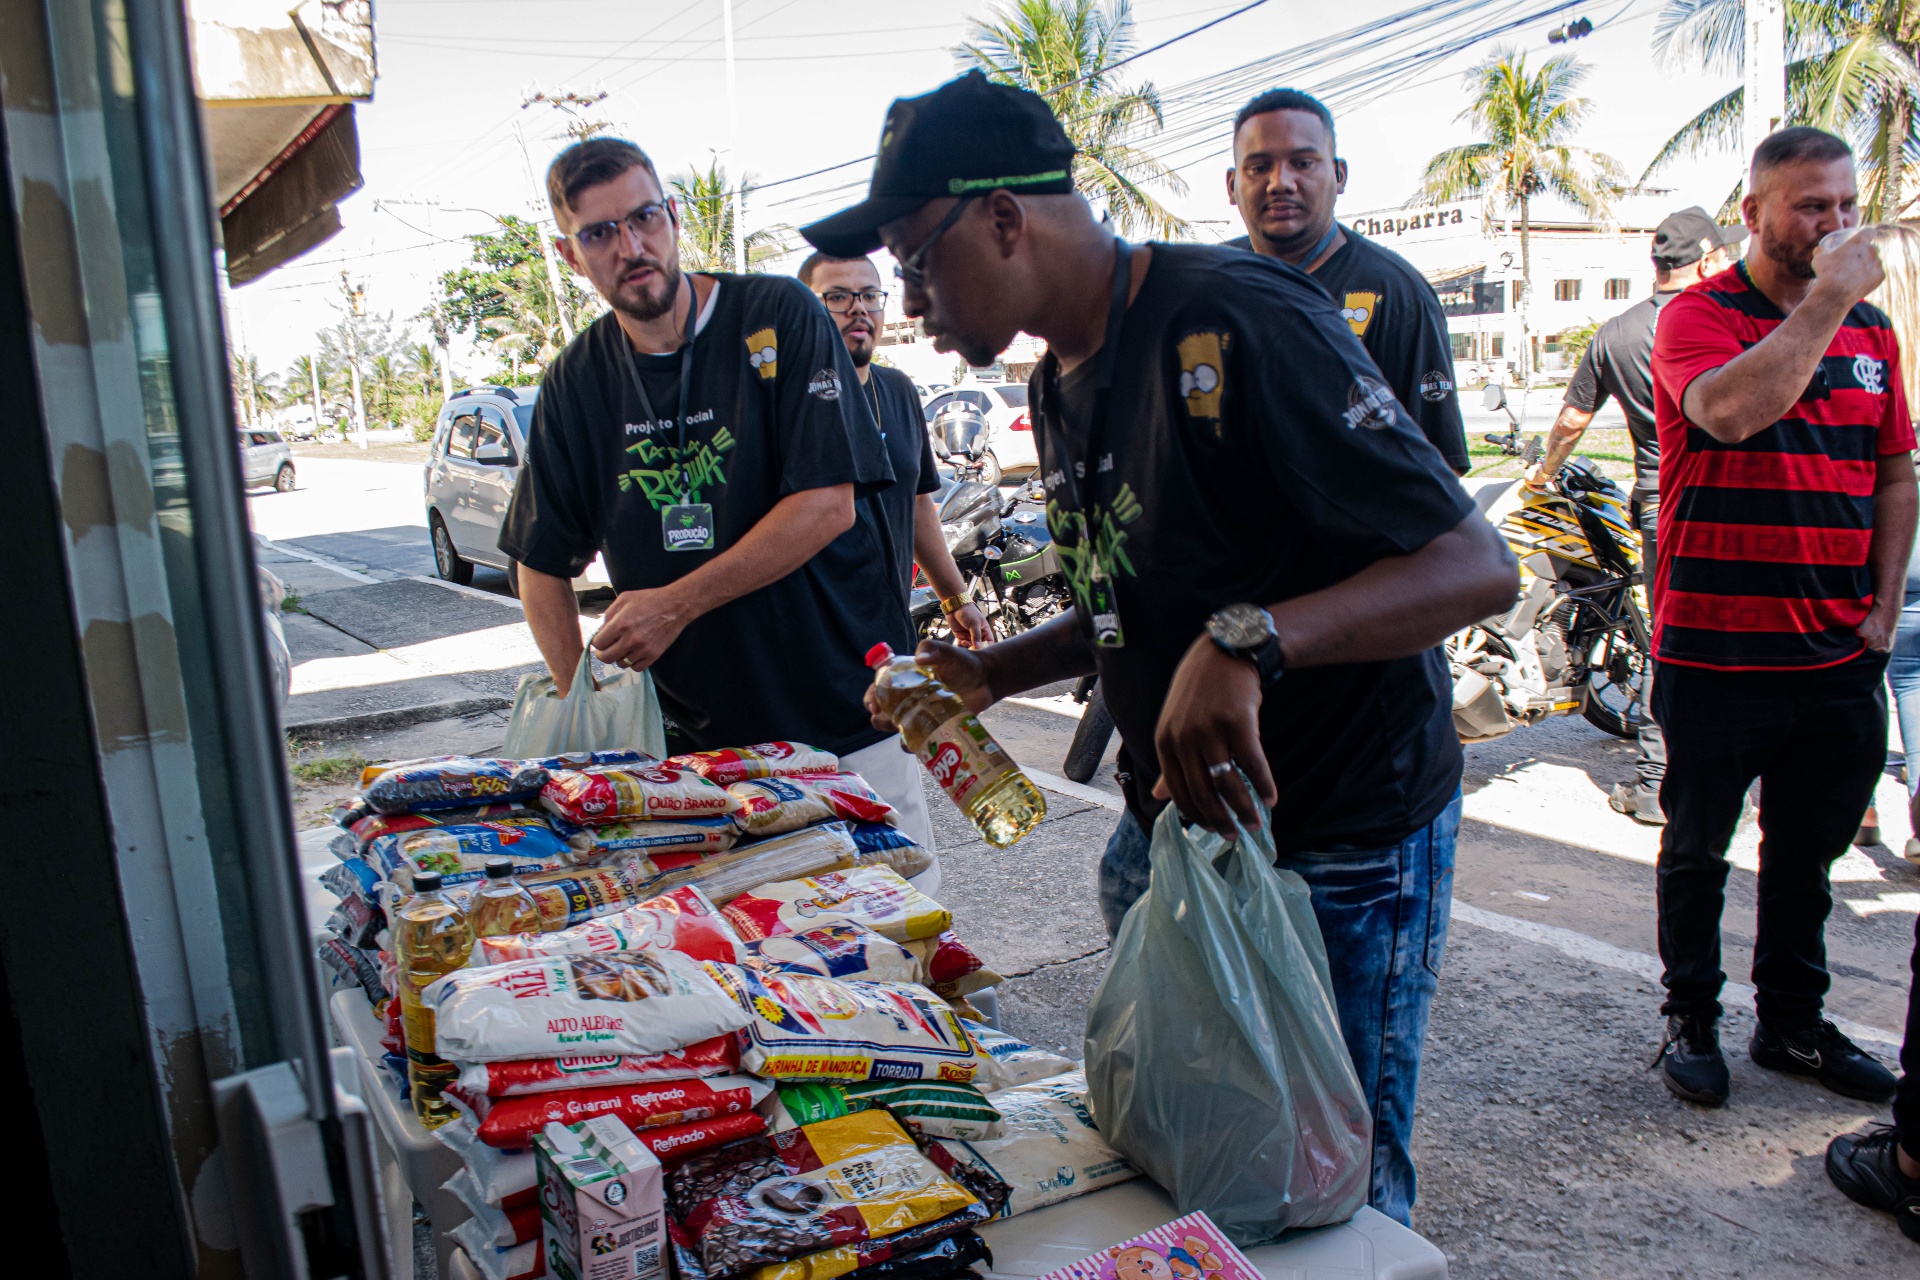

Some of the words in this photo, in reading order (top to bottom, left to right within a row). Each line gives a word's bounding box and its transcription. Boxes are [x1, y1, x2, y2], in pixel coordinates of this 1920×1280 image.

[1352, 208, 1463, 237] Chaparra
[677, 409, 714, 425] ocial
[667, 526, 709, 543] PRODUÇÃO
[1520, 509, 1636, 549] TWISER
[648, 796, 681, 810] OURO
[683, 797, 726, 810] BRANCO
[547, 1017, 579, 1033] ALTO
[580, 1015, 624, 1031] ALEGRE
[804, 1060, 817, 1074] DE
[876, 1063, 920, 1079] TORRADA
[939, 1065, 972, 1082] Rosa
[567, 1096, 621, 1114] Guarani
[631, 1087, 685, 1108] Refinado
[653, 1129, 705, 1152] Refinado
